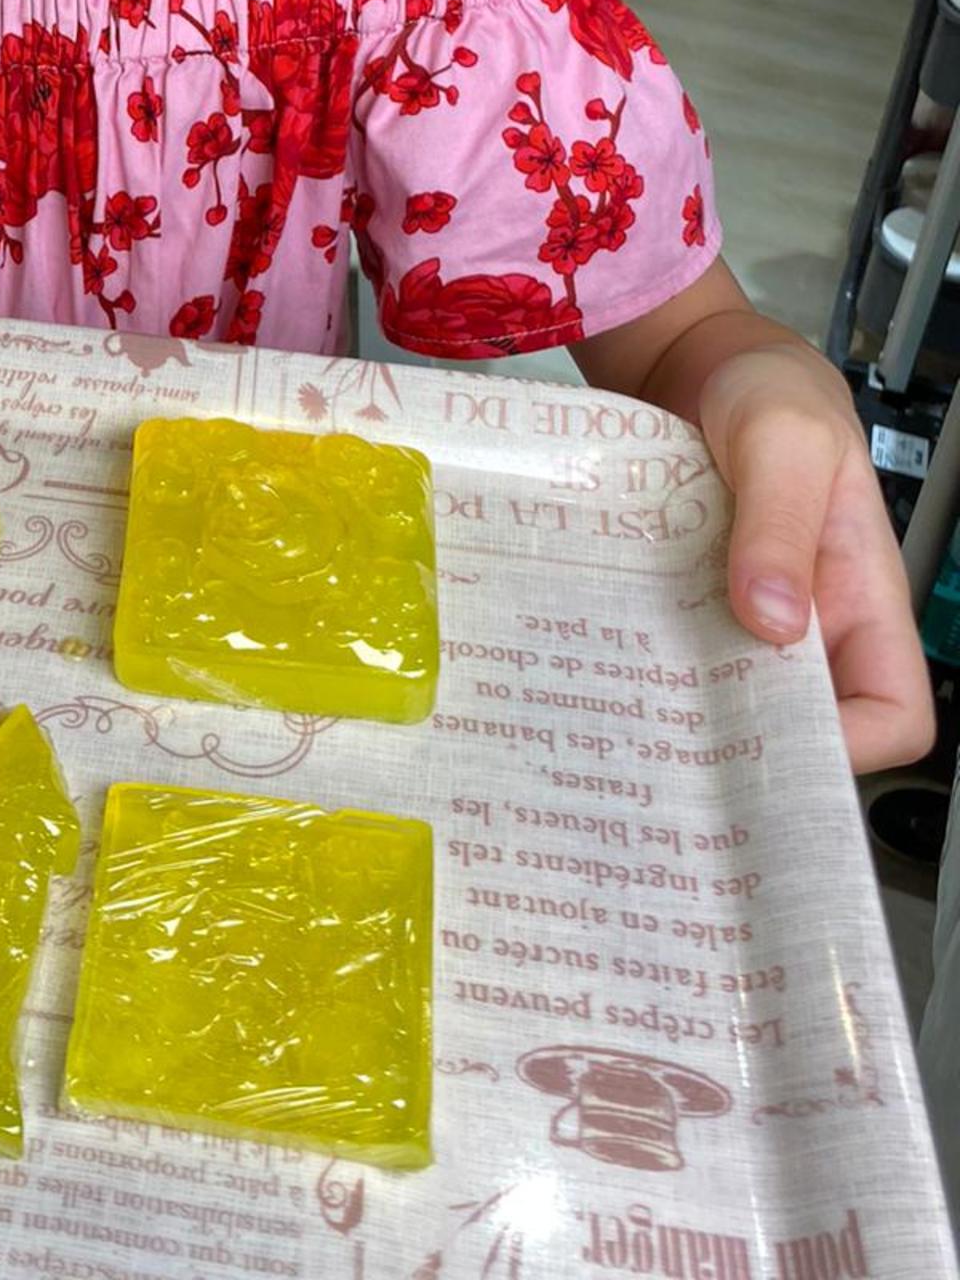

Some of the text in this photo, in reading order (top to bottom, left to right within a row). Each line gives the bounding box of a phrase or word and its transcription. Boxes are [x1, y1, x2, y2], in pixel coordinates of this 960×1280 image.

[0, 395, 63, 422] crêpes
[70, 376, 201, 404] semi-épaisse
[69, 406, 97, 434] les
[442, 391, 511, 432] DU
[624, 454, 707, 493] QUI
[508, 499, 570, 532] LA
[591, 498, 708, 544] C'EST
[514, 613, 652, 654] à la pâte.
[437, 638, 754, 692] des pépites de chocola
[475, 680, 705, 734] des pommes ou
[430, 712, 764, 768] fromage, des bananes
[540, 767, 654, 808] fraises,
[449, 797, 750, 856] que les bleuets, les
[446, 839, 761, 902] des ingrédients tels
[465, 886, 754, 952] salée en ajoutant
[439, 928, 482, 955] ou
[492, 937, 600, 973] sucrée
[611, 956, 708, 997] faites
[453, 980, 784, 1049] Les crêpes peuvent
[52, 1142, 207, 1186] proportions
[38, 1176, 104, 1209] telles
[24, 1211, 181, 1257] contiennent
[112, 1189, 304, 1241] sensibilisation
[187, 1240, 232, 1265] qui
